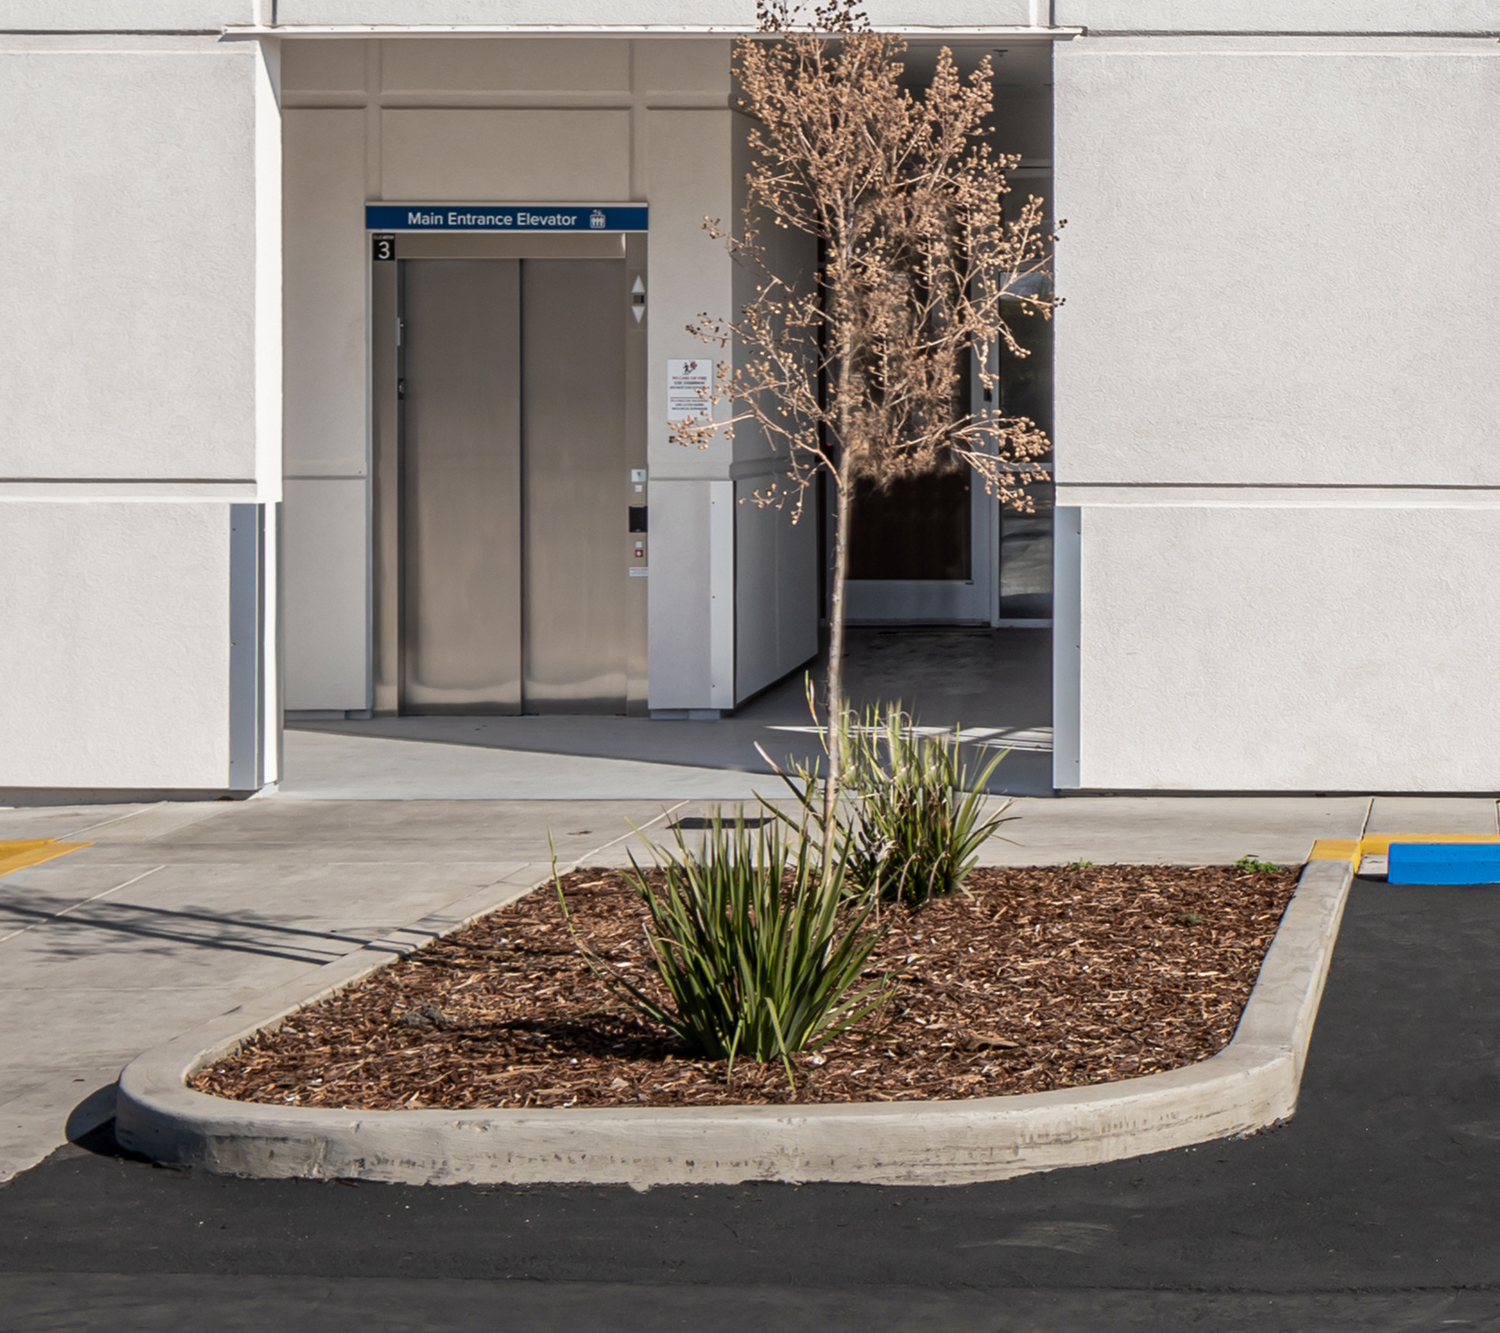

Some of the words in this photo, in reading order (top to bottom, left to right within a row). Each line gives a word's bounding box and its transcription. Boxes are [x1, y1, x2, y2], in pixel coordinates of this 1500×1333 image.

[407, 212, 443, 226] Main
[448, 212, 513, 226] Entrance
[517, 212, 577, 226] Elevator
[378, 241, 390, 260] 3
